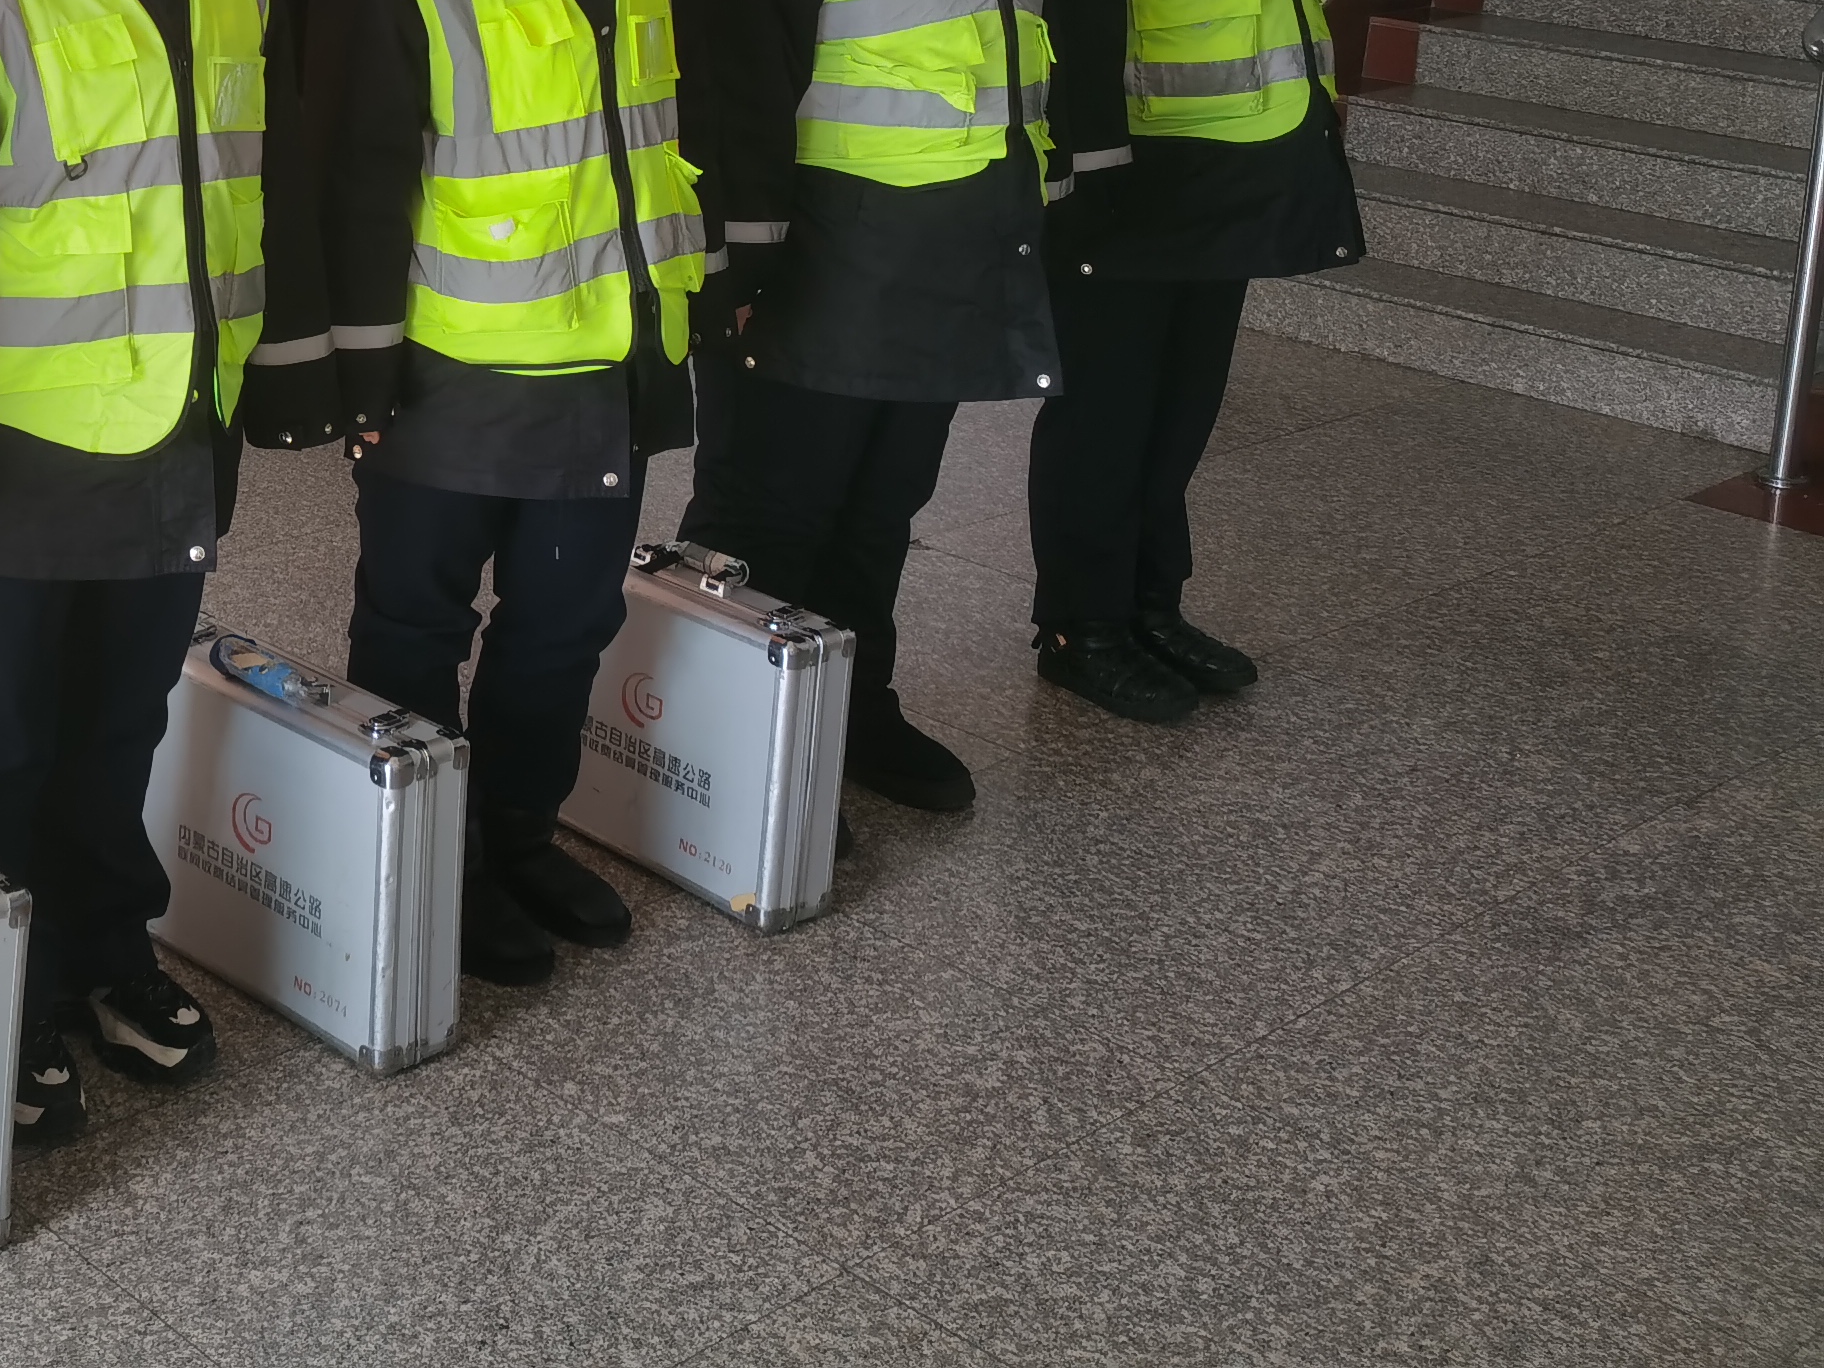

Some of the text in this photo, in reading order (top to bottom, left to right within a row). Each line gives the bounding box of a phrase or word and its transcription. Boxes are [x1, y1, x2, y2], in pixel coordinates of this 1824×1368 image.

[179, 823, 323, 920] 内蒙古自治区高速公路
